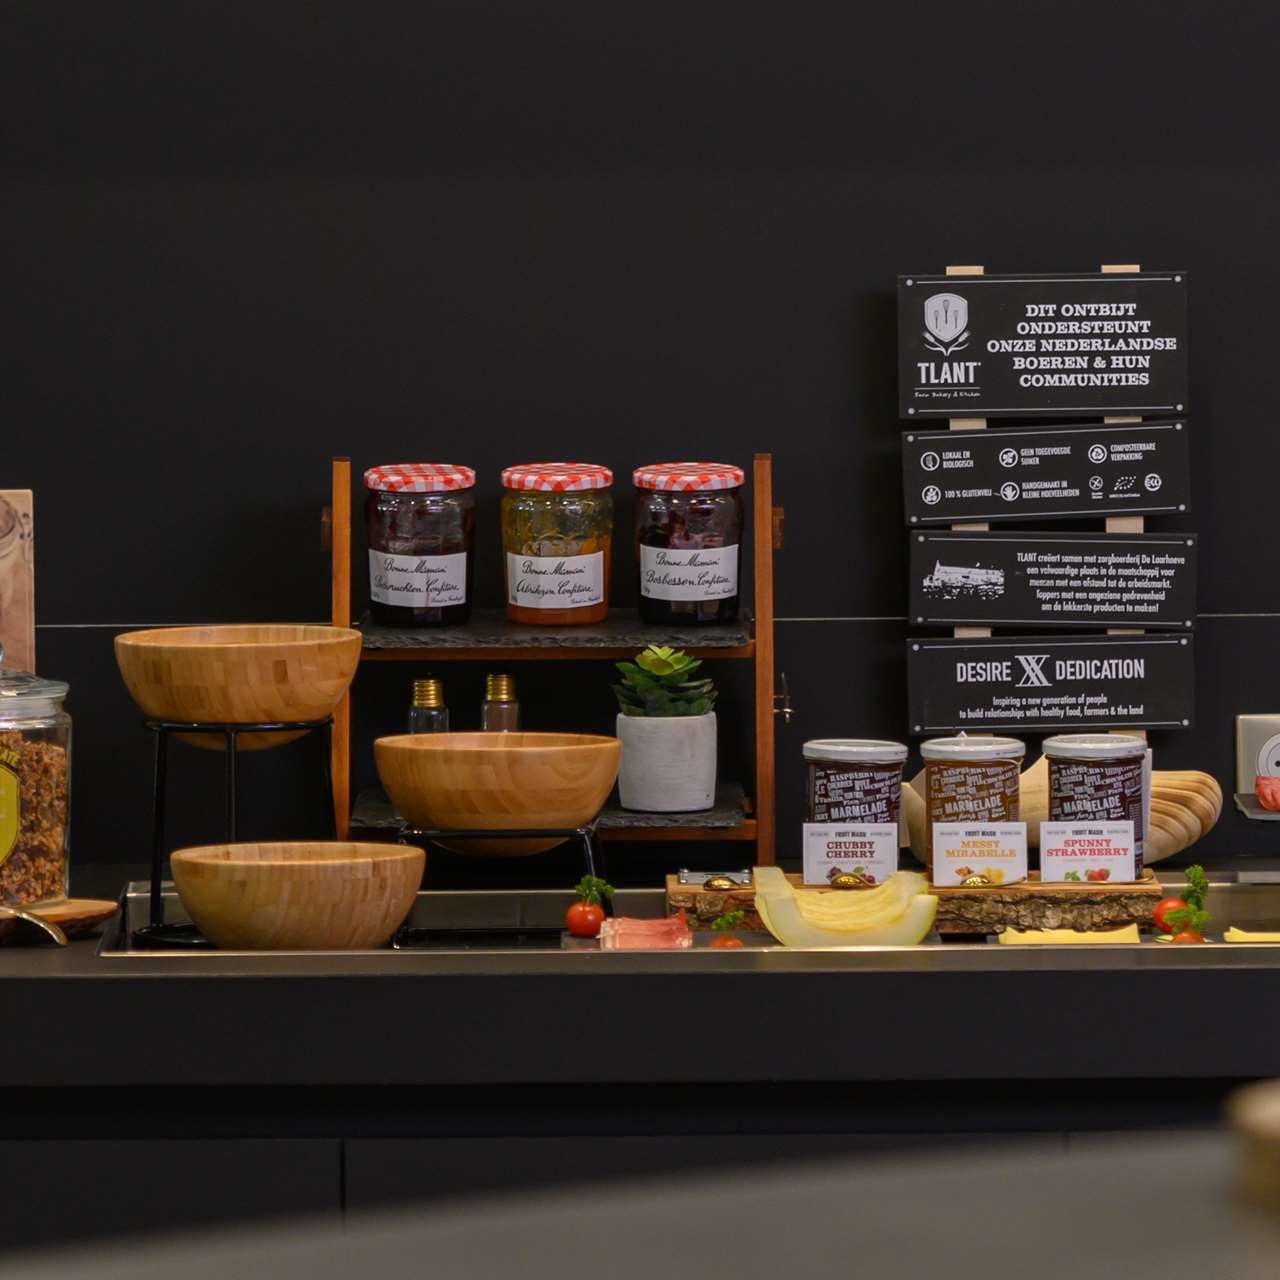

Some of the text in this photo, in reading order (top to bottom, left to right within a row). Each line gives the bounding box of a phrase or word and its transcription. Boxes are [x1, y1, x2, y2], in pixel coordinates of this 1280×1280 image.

[1026, 304, 1136, 317] DIT ONTBIJT
[1016, 321, 1151, 334] ONDERSTEUNT
[987, 338, 1176, 352] ONZE NEDERLANDSE
[1013, 355, 1150, 369] BOEREN & HUN
[917, 362, 978, 384] TLANT
[1019, 373, 1149, 387] COMMUNITIES
[945, 490, 955, 498] 100
[656, 552, 681, 566] Bonne
[1017, 552, 1037, 562] TLANT
[1141, 554, 1150, 563] De
[384, 558, 408, 572] Bonne
[522, 560, 548, 575] Bonne
[1100, 566, 1106, 575] in
[1108, 566, 1116, 575] de
[1118, 578, 1126, 587] de
[1054, 601, 1061, 610] de
[956, 662, 1011, 682] DESIRE
[1055, 659, 1144, 680] DEDICATION
[993, 696, 1020, 707] Inspiring
[1042, 696, 1076, 706] generation
[1078, 694, 1084, 703] of
[1086, 694, 1107, 705] people
[960, 705, 1143, 719] to build relationships with healthy food, farmers & the land
[830, 800, 887, 819] MARMELADE
[944, 795, 1002, 814] MARMELADE
[1063, 795, 1120, 814] MARMELADE
[826, 841, 875, 849] CHUBBY
[961, 840, 1000, 848] MESSY
[826, 850, 875, 858] CHERRY
[945, 849, 1016, 857] MIRABELLE
[1047, 848, 1129, 856] STRAWBERRY
